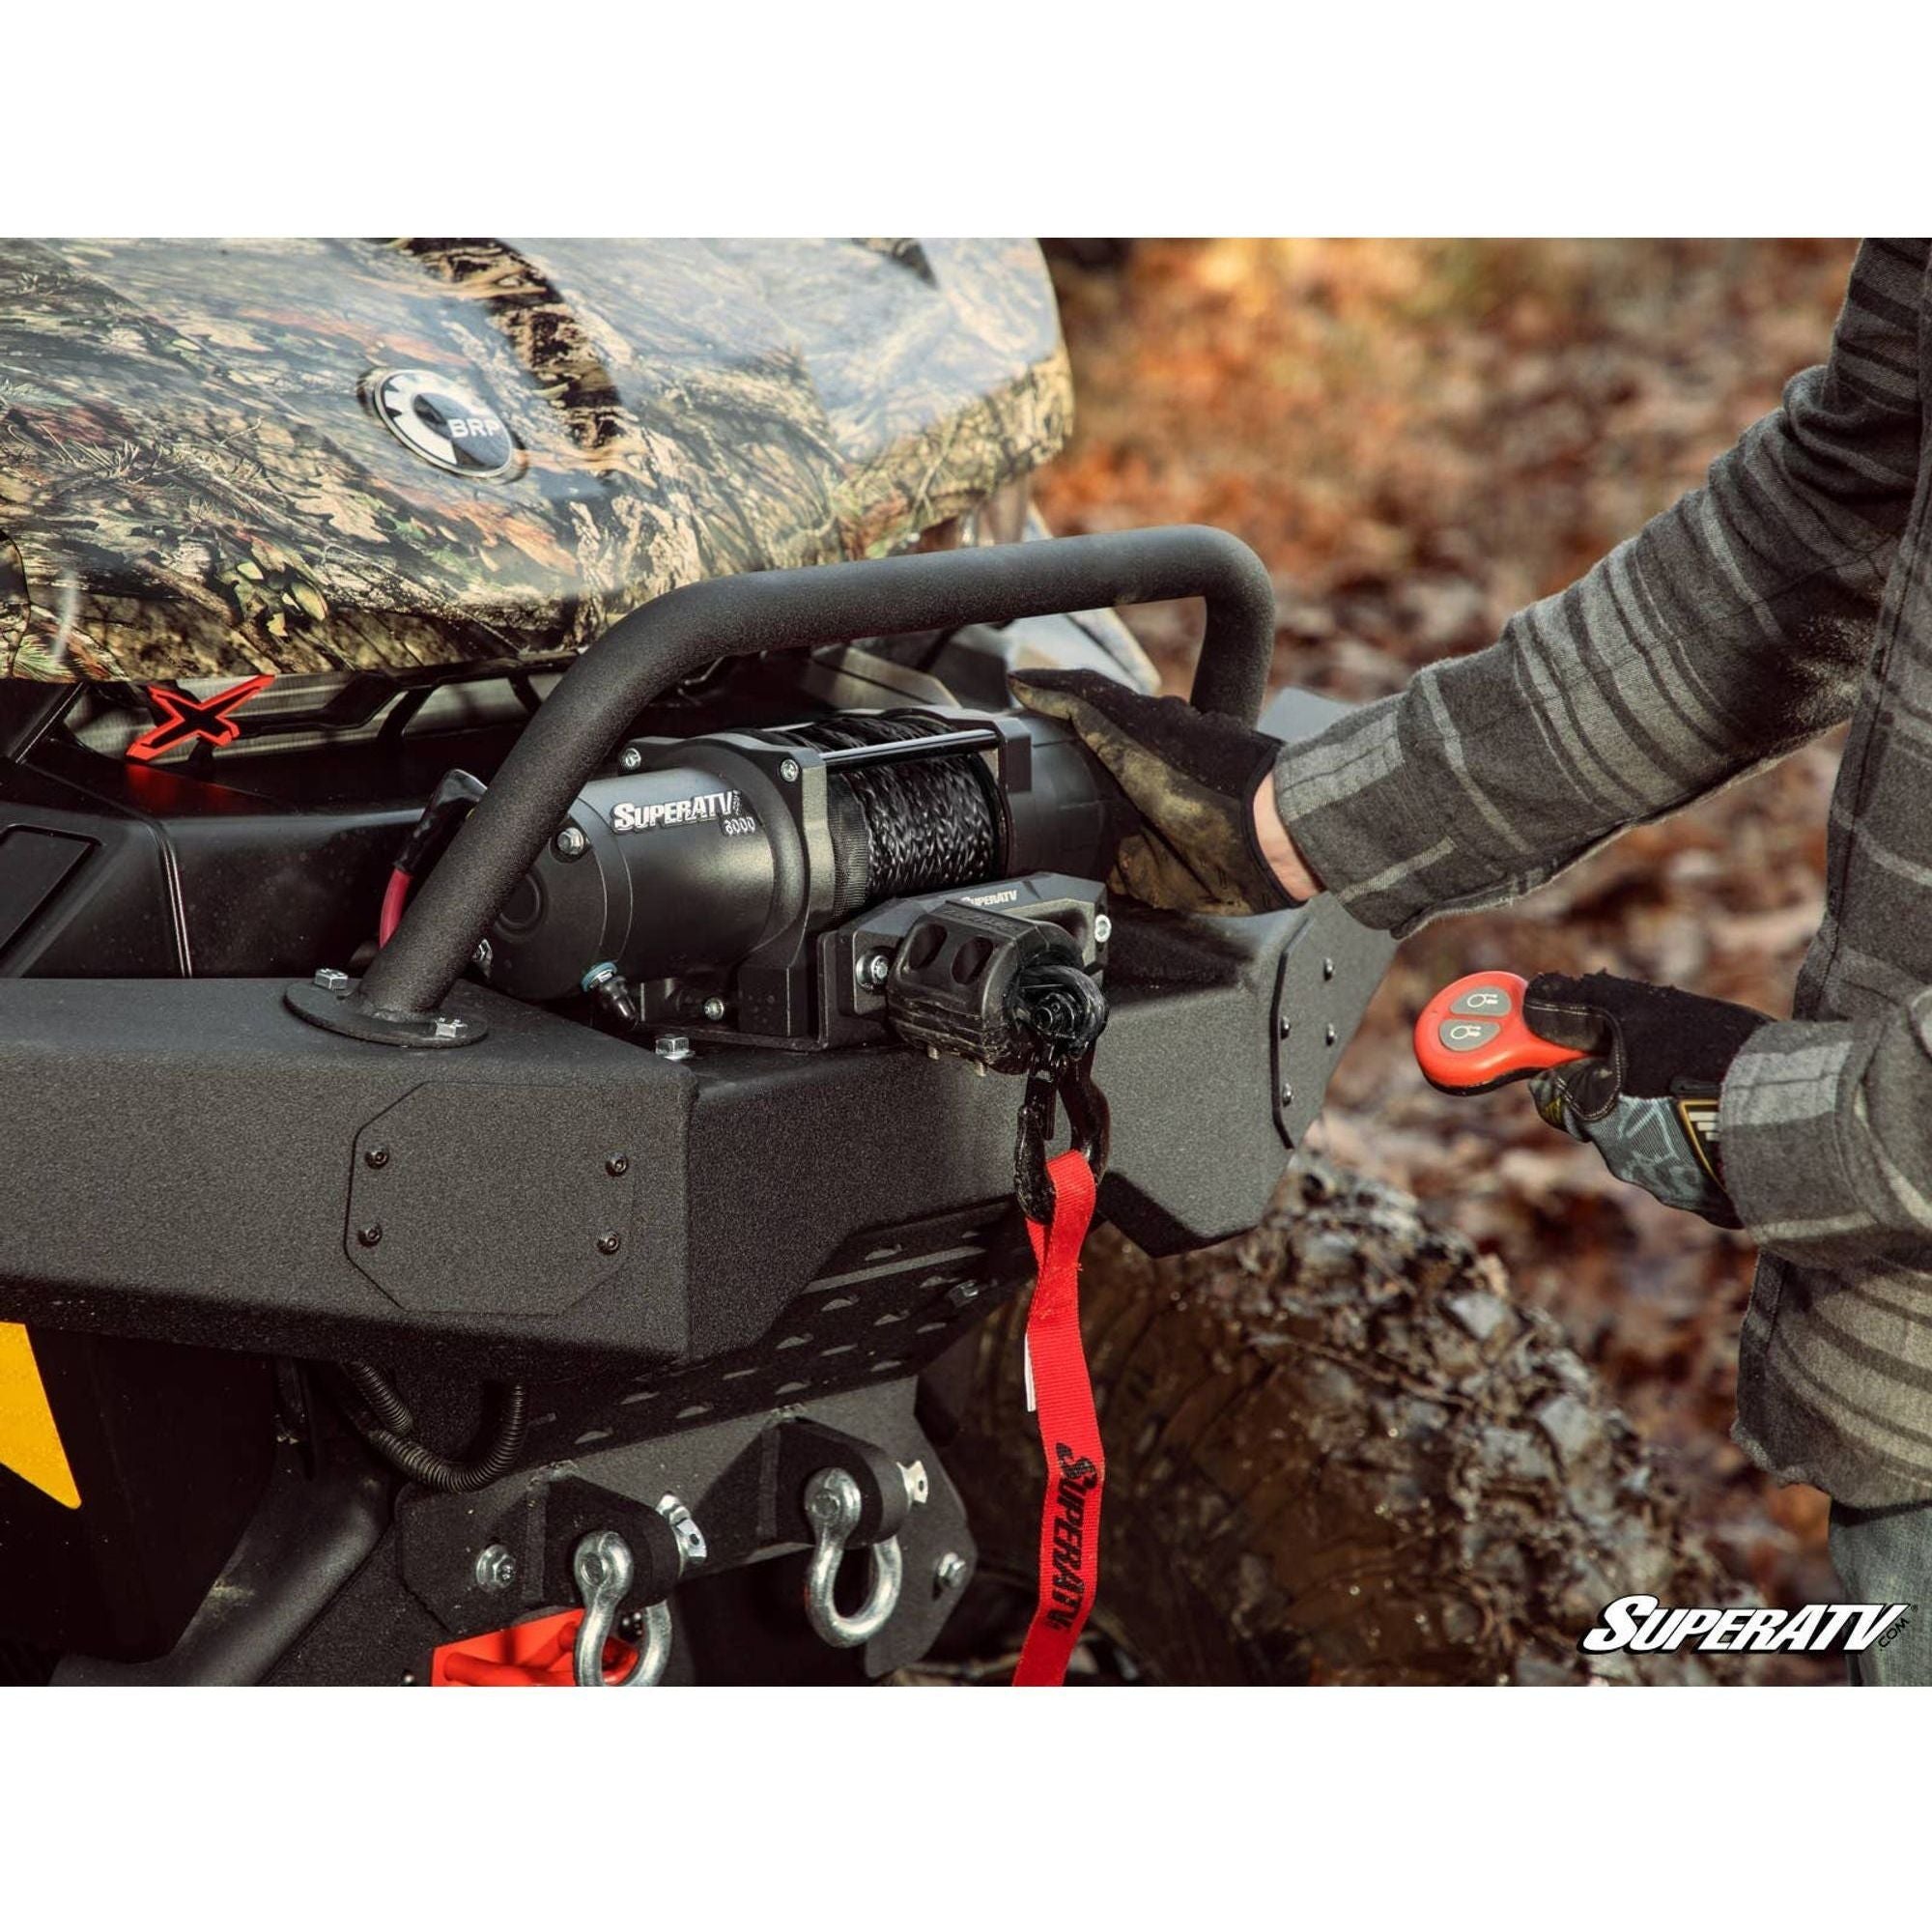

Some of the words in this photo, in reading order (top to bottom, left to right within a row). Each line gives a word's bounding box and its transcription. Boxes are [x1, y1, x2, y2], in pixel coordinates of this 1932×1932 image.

[447, 418, 500, 438] BRP
[611, 790, 732, 830] SUPERATV
[1046, 1442, 1098, 1631] SUPERATV
